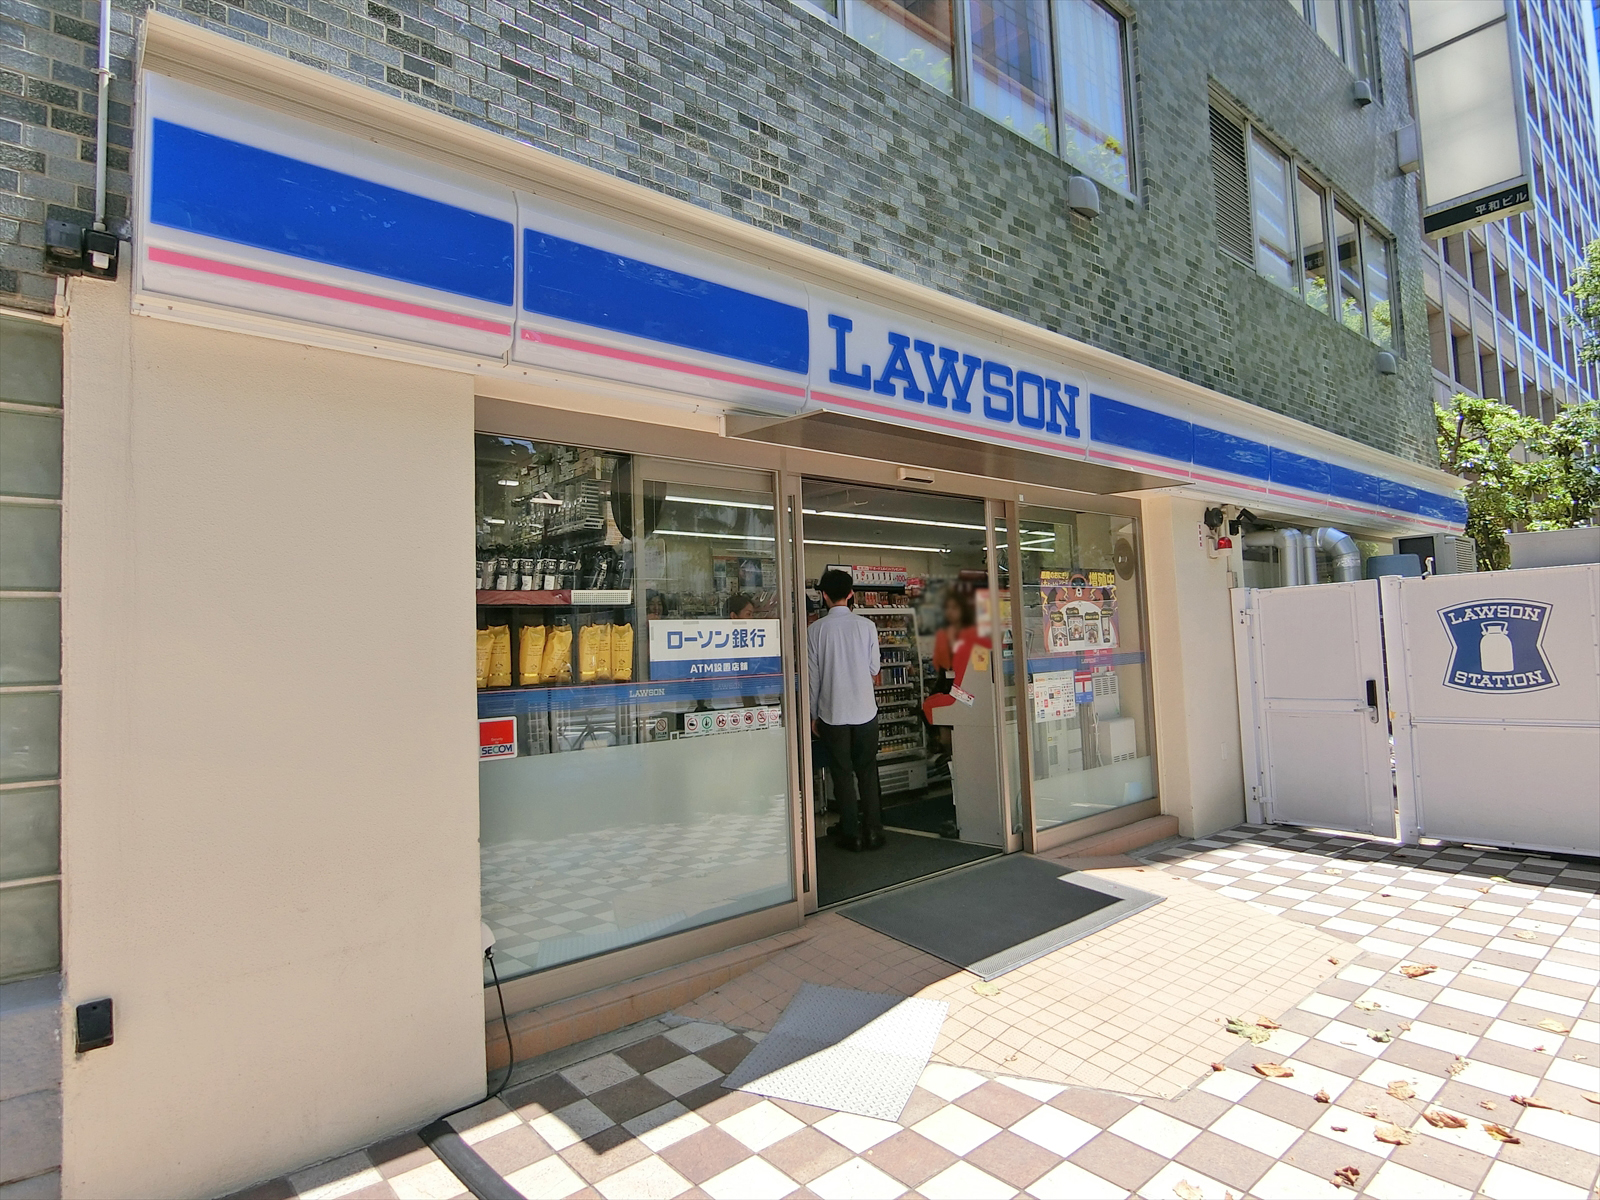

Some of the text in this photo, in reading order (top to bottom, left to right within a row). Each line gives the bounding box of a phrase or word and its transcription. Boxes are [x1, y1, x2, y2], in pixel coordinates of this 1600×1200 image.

[1475, 192, 1527, 215] 平和ビル
[828, 313, 1081, 439] LAWSON
[1447, 605, 1542, 625] LAWSON
[667, 628, 766, 650] ローソン銀行
[690, 662, 748, 674] ATM設置店舗
[1454, 670, 1546, 688] STATION
[629, 688, 665, 698] LAWSON
[481, 744, 513, 755] SECOM
